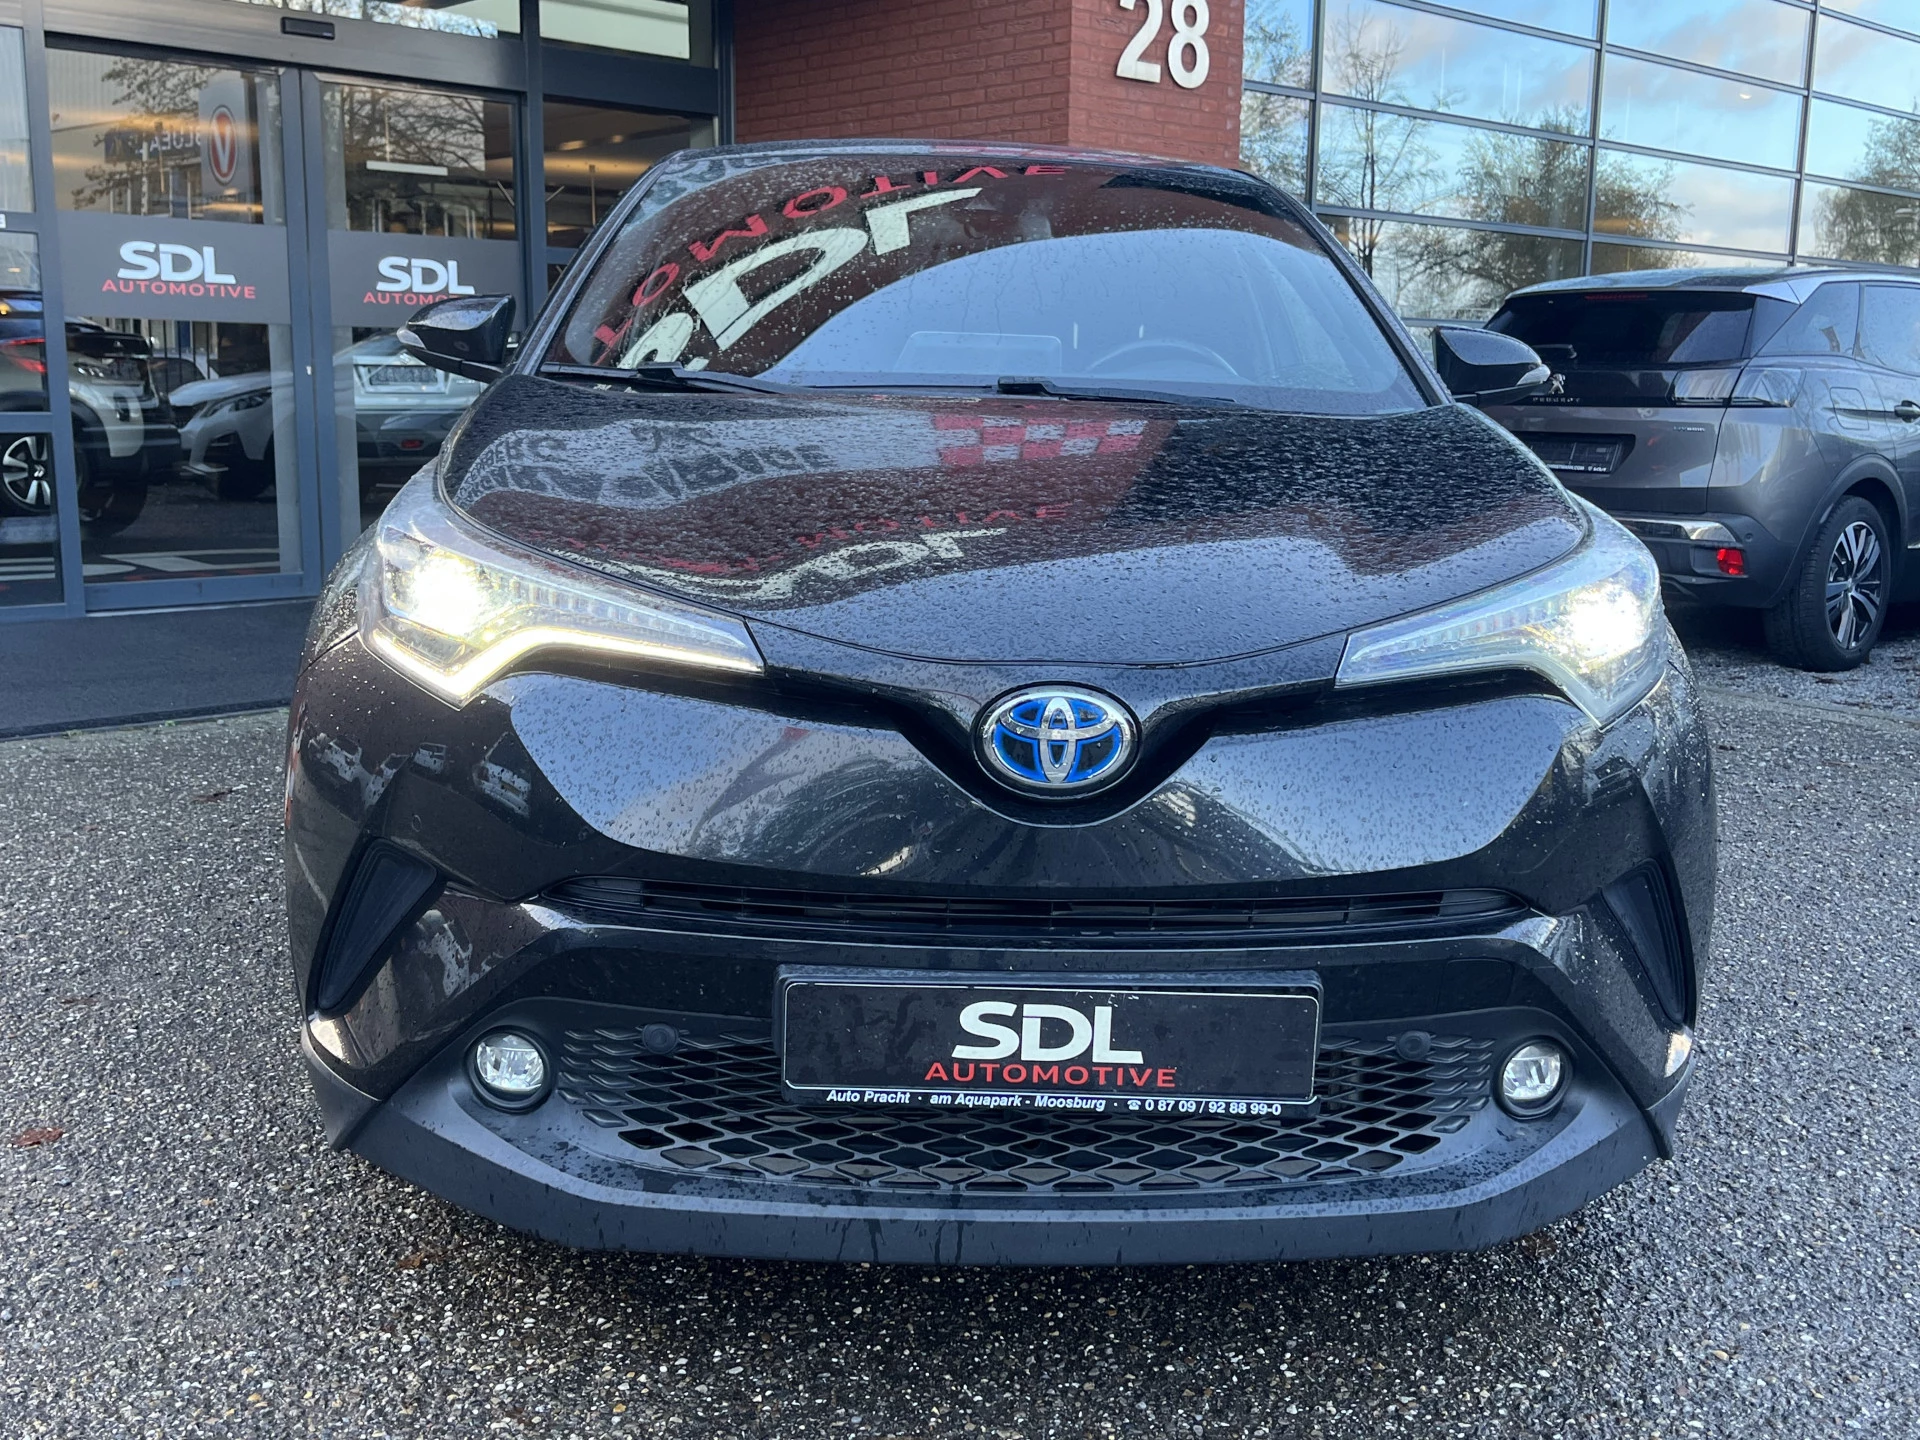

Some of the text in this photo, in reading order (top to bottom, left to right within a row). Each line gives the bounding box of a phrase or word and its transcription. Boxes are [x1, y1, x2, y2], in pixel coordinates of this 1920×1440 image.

[1116, 0, 1210, 89] 28
[117, 240, 237, 285] SDL
[376, 256, 476, 295] SDL
[102, 279, 256, 299] AUTOMOTIVE
[951, 1000, 1144, 1065] SDL
[925, 1062, 1177, 1088] AUTOMOTIVE
[826, 1090, 861, 1103] Auto
[863, 1090, 911, 1104] Pracht
[930, 1094, 952, 1105] am
[954, 1093, 1023, 1108] Aquapark
[1034, 1096, 1106, 1112] Moosburg
[1157, 1100, 1174, 1112] 87
[1179, 1100, 1196, 1113] 09
[1208, 1102, 1225, 1114] 92
[1229, 1102, 1247, 1115] 88
[1250, 1102, 1281, 1116] 99-0
